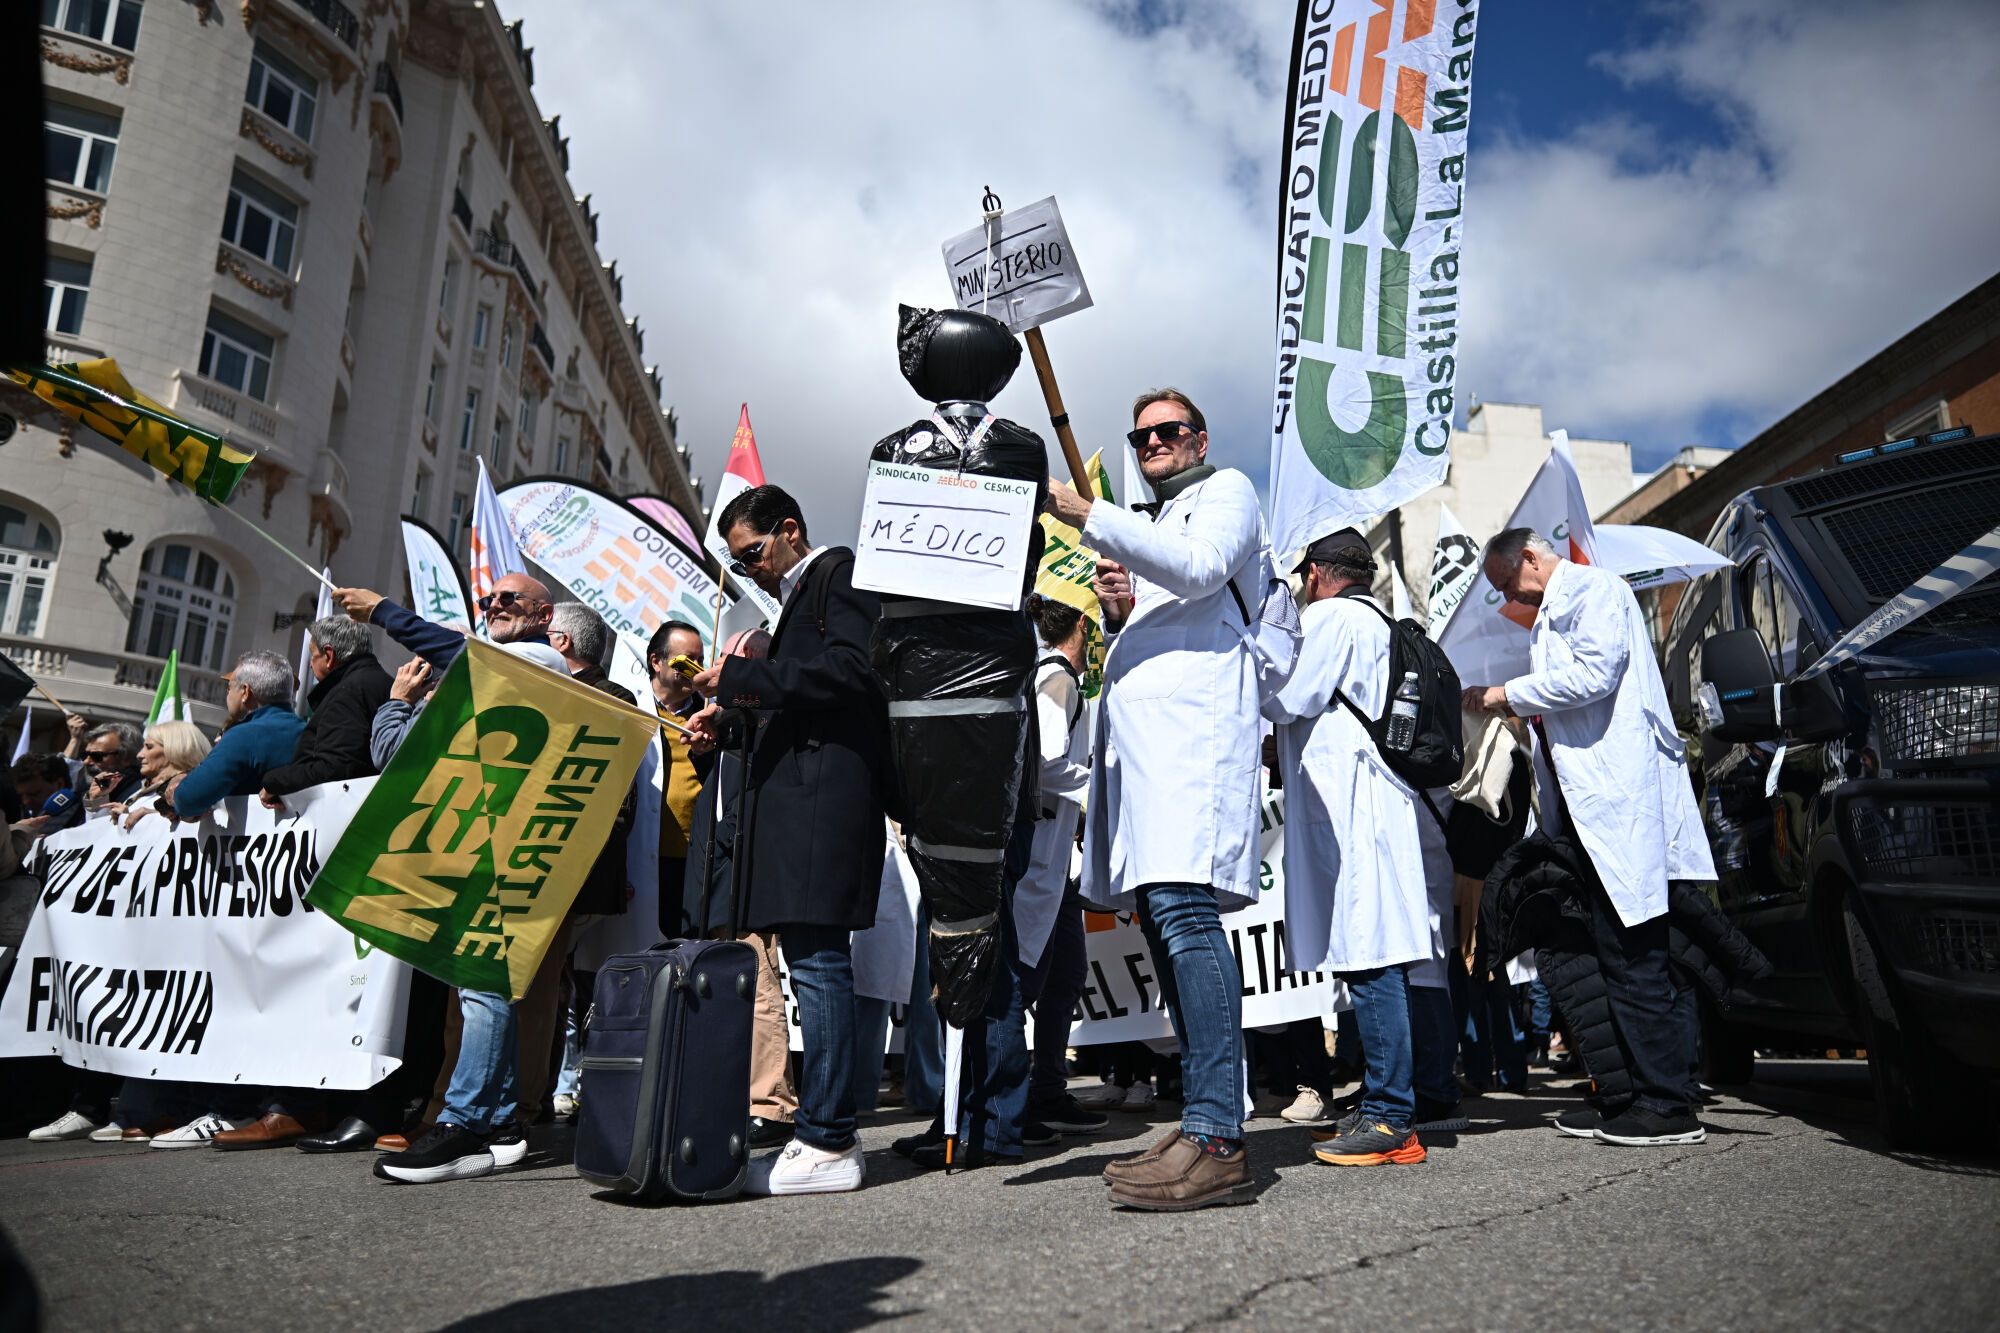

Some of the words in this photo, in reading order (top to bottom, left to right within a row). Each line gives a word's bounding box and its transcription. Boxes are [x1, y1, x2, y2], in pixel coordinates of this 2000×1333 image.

[957, 241, 1062, 300] MINISTERIO
[1275, 164, 1315, 434] SINDICATO
[876, 467, 930, 482] SINDICATO
[936, 474, 978, 489] MÉDICO
[984, 482, 1030, 495] CESM-CV
[871, 514, 1006, 557] MÉDICO
[71, 845, 138, 917] DE
[150, 811, 321, 919] PROFESIÓN
[26, 956, 214, 1055] FACULTATIVA
